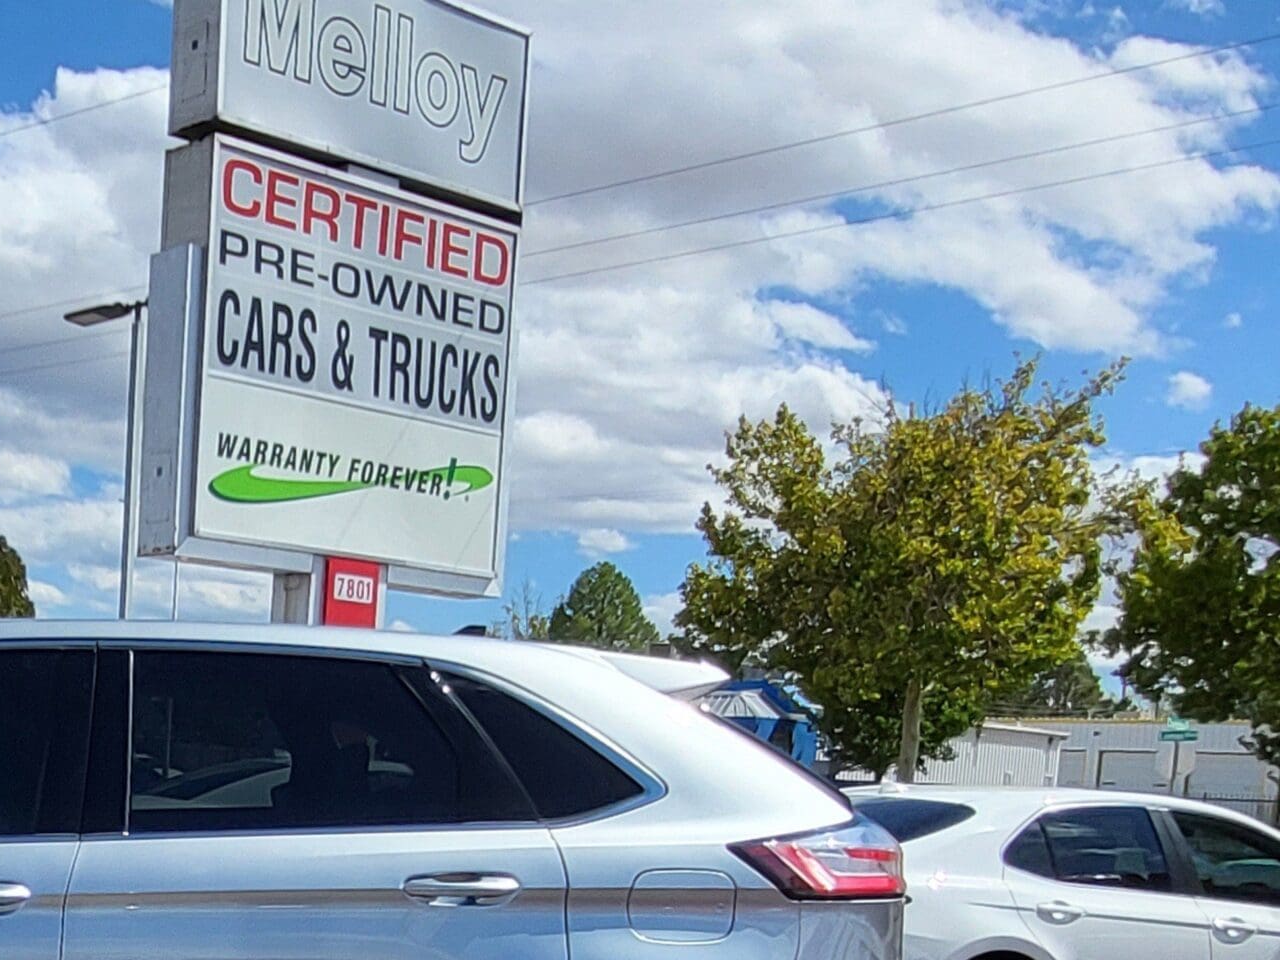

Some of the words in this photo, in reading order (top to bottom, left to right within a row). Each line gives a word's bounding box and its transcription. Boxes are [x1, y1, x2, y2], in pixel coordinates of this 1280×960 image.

[243, 0, 508, 164] Melloy
[222, 158, 509, 287] CERTIFIED
[219, 229, 505, 335] PRE-OWNED
[217, 289, 318, 383] CARS
[331, 319, 355, 392] &
[368, 326, 500, 423] TRUCKS
[216, 431, 341, 478] WARRANTY
[347, 457, 458, 500] FOREVER!
[337, 577, 371, 601] 7801
